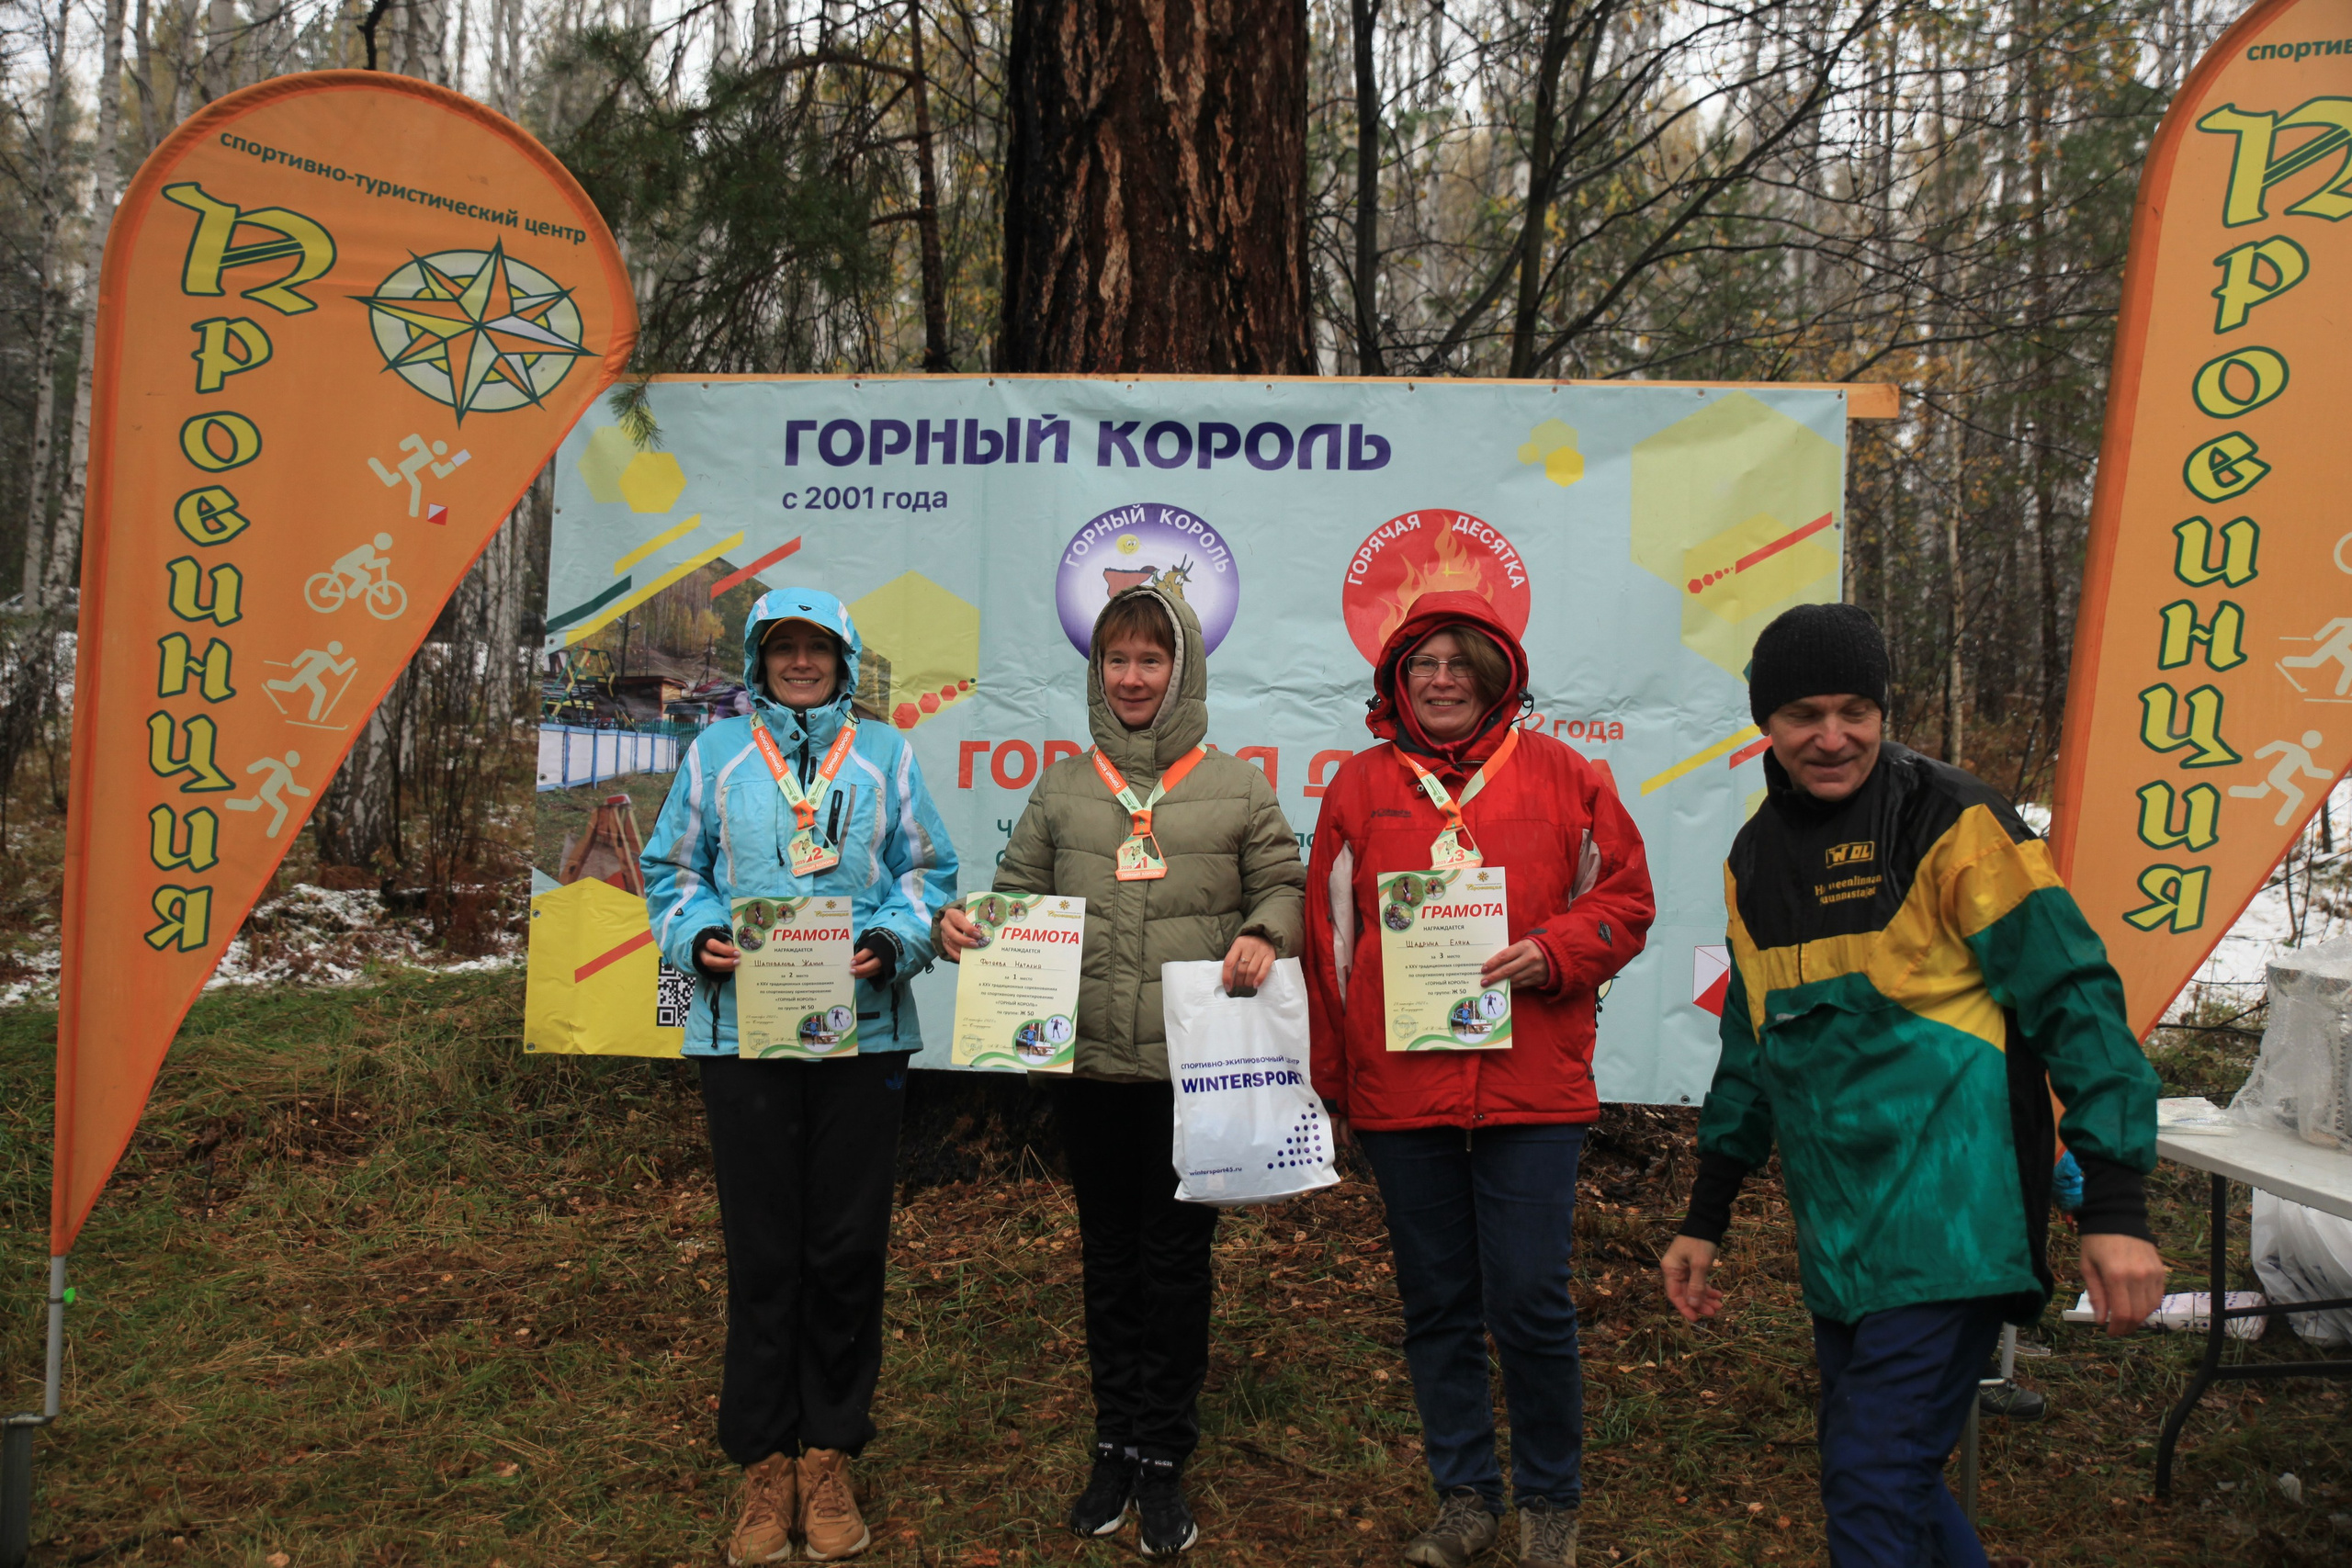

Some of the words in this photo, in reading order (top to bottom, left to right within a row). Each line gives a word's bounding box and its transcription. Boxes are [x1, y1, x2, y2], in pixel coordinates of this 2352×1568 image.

[220, 130, 520, 229] спортивно-туристический
[523, 215, 587, 245] центр
[784, 413, 1070, 467] ГОРНЫЙ
[1096, 420, 1392, 471] КОРОЛЬ
[782, 491, 797, 510] с
[804, 486, 875, 511] 2001
[882, 488, 949, 513] года
[1065, 503, 1146, 568] ГОРНЫЙ
[1159, 508, 1230, 573] КОРОЛЬ
[1348, 513, 1421, 585] ГОРЯЧАЯ
[1452, 515, 1525, 589] ДЕСЯТКА
[1553, 719, 1623, 744] года
[812, 847, 823, 861] 2
[1141, 856, 1148, 868] 1
[1454, 849, 1465, 862] 3
[1421, 903, 1503, 919] ГРАМОТА
[772, 928, 850, 942] ГРАМОТА
[1001, 927, 1080, 944] ГРАМОТА
[1182, 1069, 1305, 1093] WINTERSPORT
[1189, 1166, 1242, 1176] wintersport45.ru
